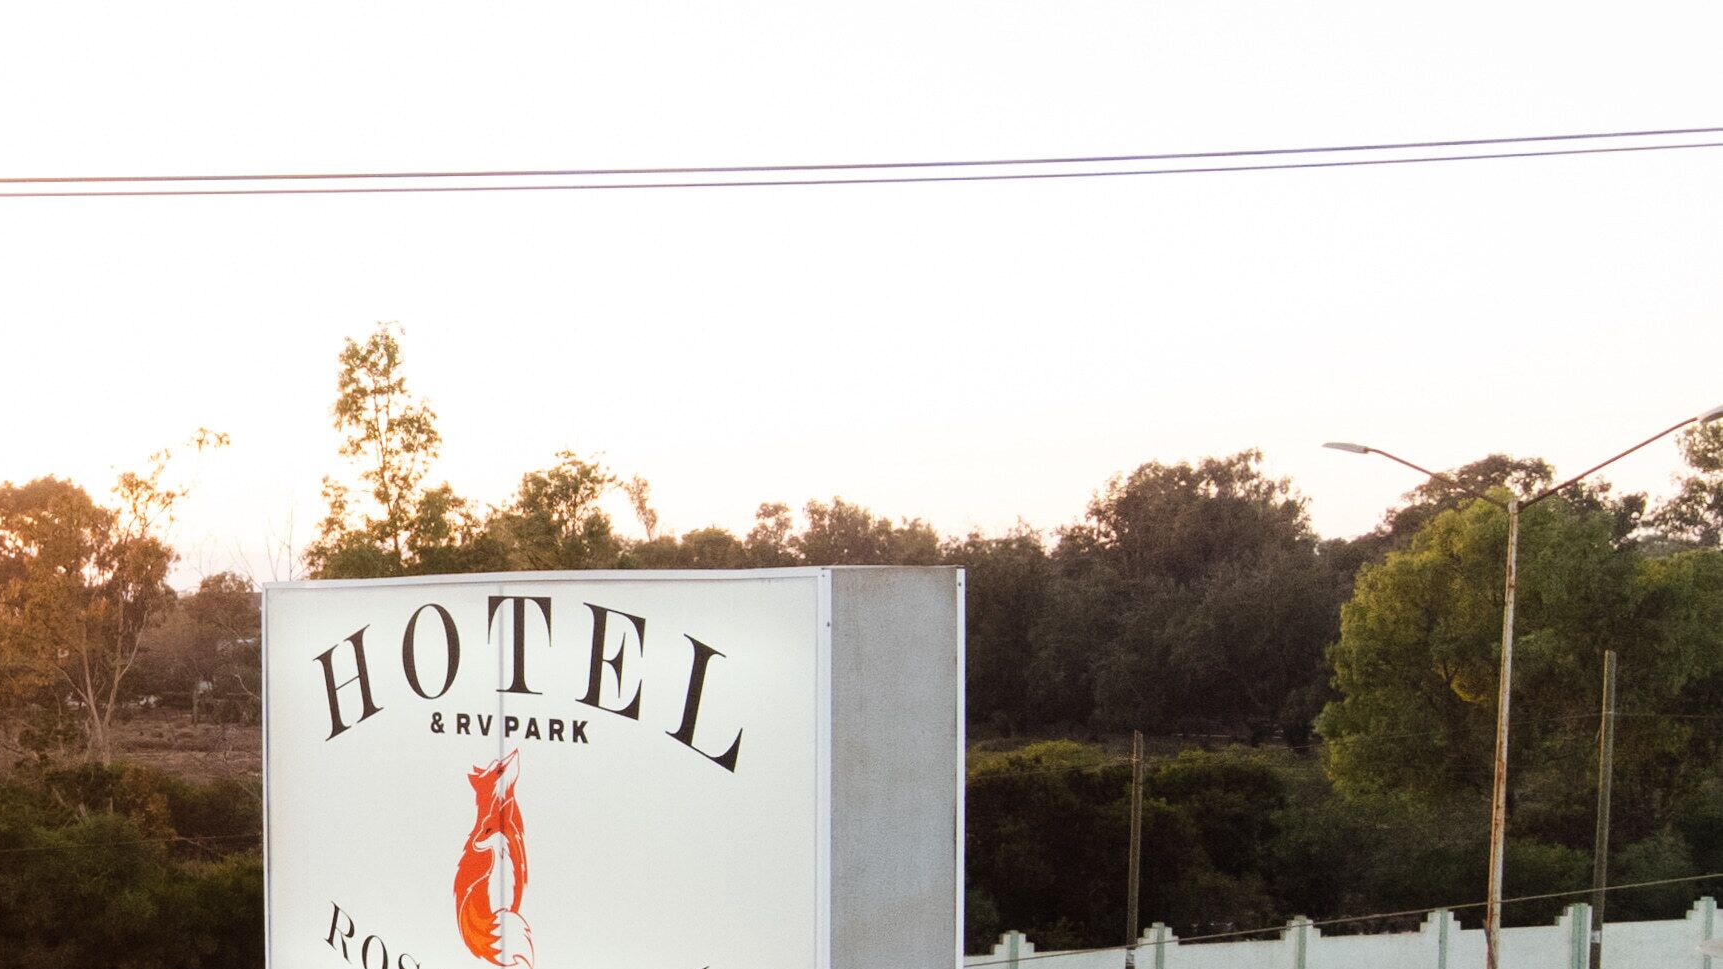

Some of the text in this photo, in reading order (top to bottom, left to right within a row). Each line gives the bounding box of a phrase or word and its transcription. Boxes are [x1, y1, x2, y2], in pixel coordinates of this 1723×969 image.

[312, 595, 744, 773] HOTEL
[430, 711, 589, 744] & RV PARK
